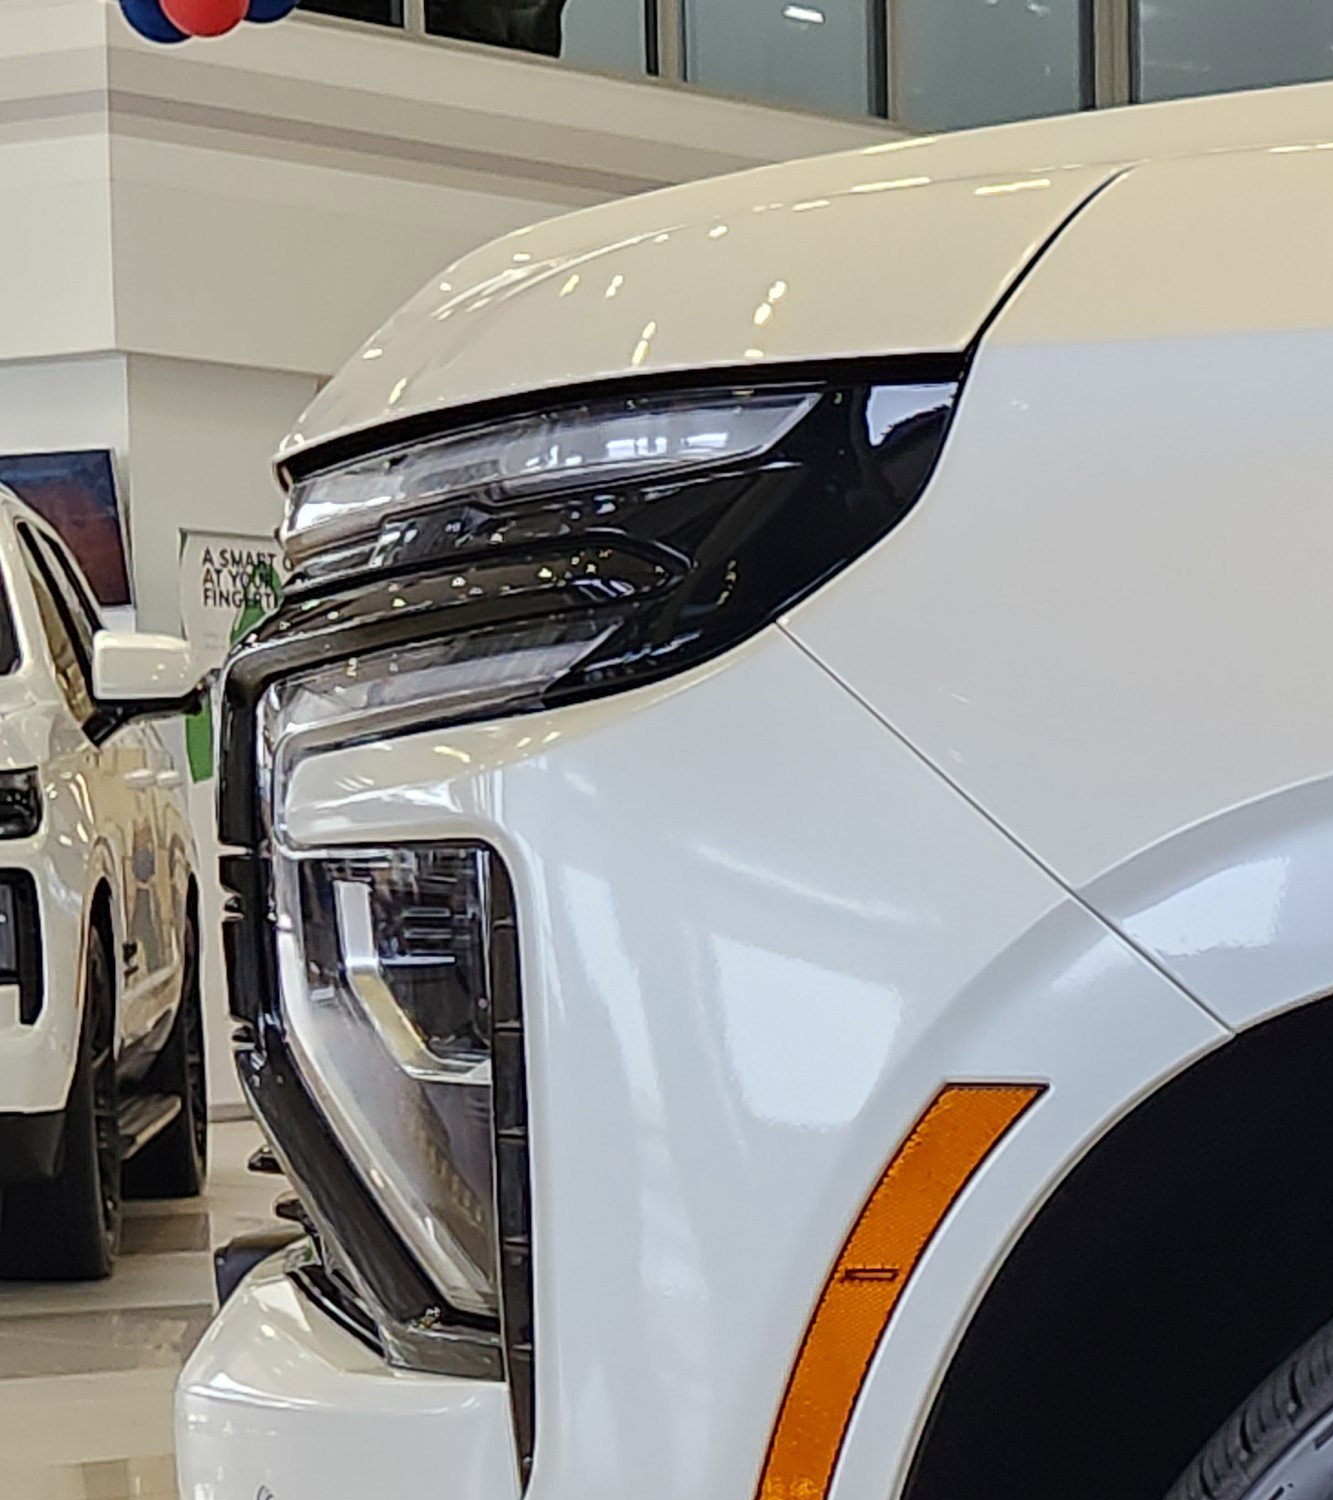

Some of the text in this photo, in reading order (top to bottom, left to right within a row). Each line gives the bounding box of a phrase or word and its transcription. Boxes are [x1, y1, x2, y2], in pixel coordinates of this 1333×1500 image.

[202, 546, 215, 566] A
[219, 548, 277, 569] SMART
[202, 567, 224, 588] AT
